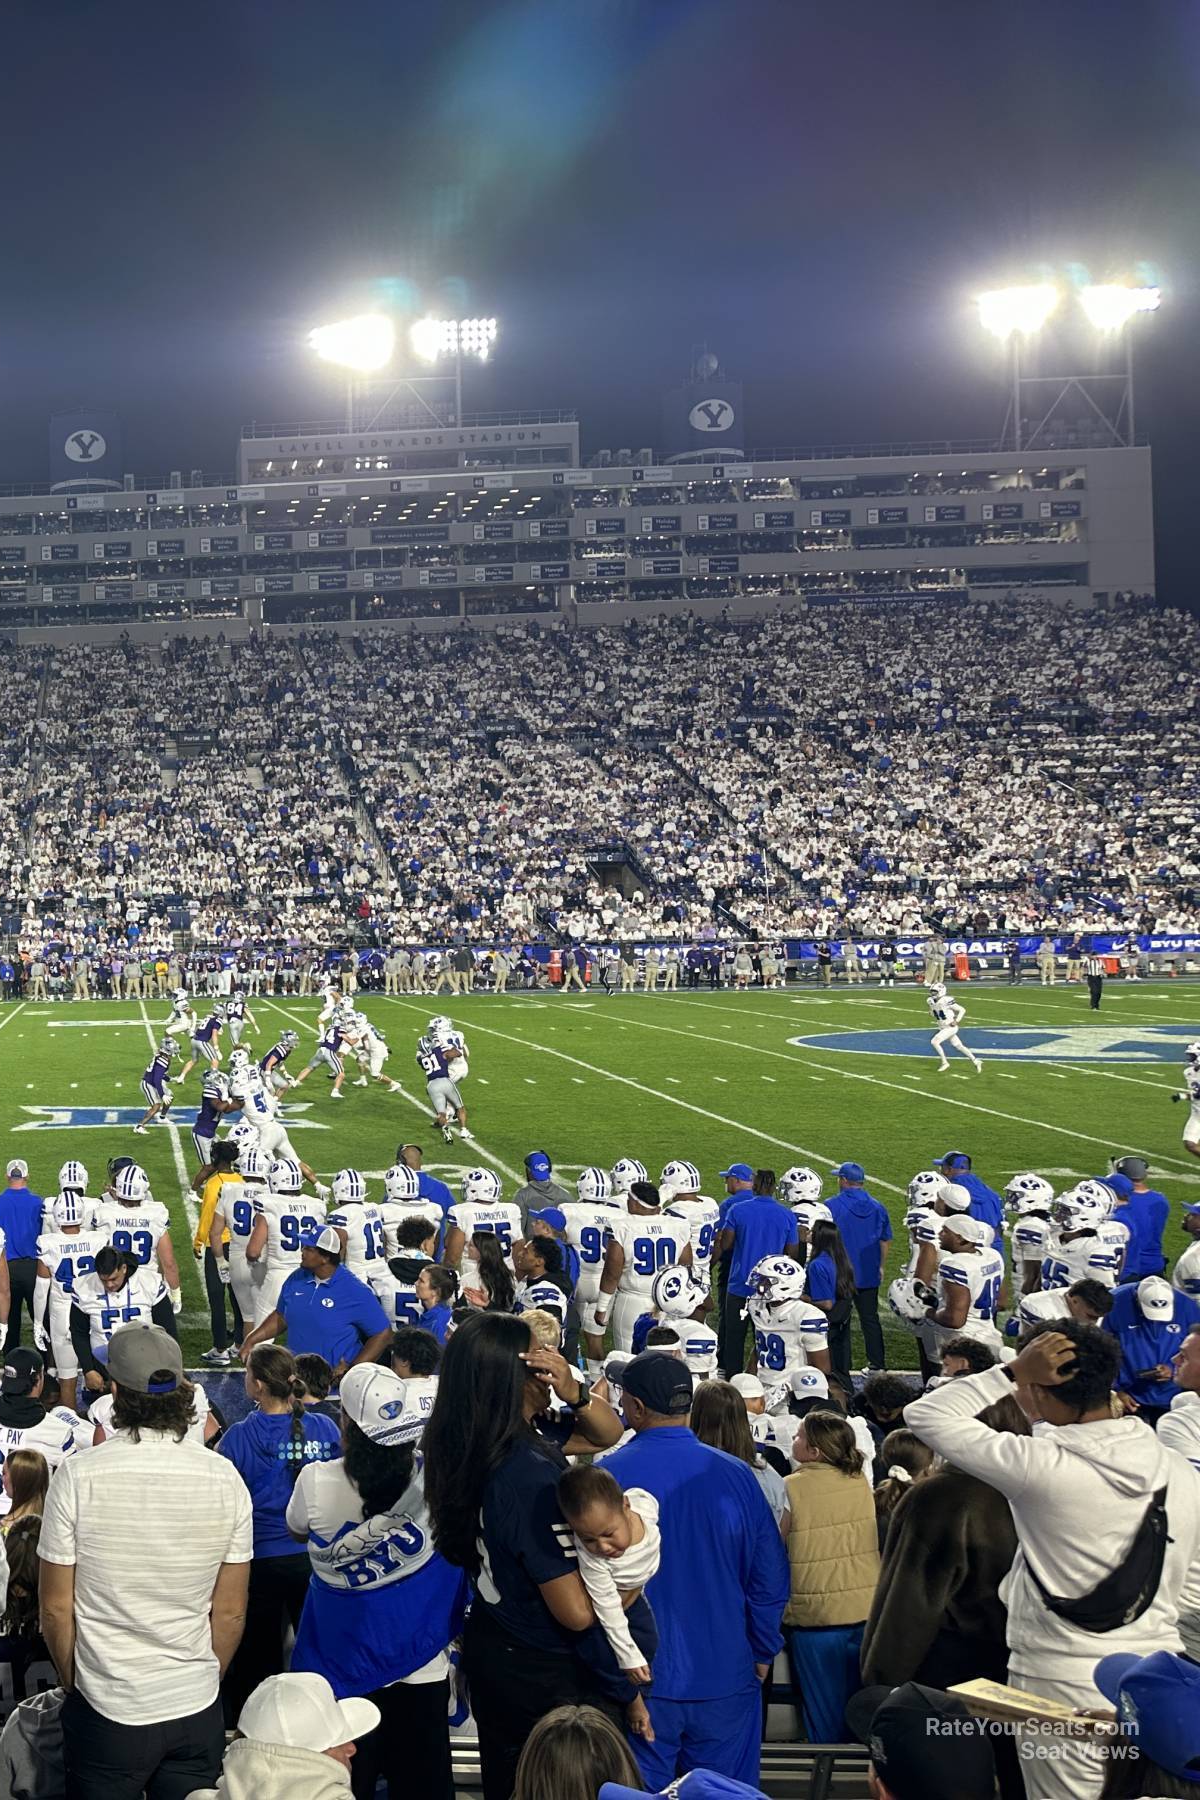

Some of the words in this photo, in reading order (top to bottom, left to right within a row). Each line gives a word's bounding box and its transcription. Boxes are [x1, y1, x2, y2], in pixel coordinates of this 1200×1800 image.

[697, 402, 728, 428] Y
[71, 433, 100, 459] Y
[279, 441, 343, 454] LAVELL
[358, 436, 444, 448] EDWARDS
[459, 431, 542, 444] STADIUM
[1151, 939, 1182, 948] BYU
[421, 1053, 442, 1075] 91
[115, 1217, 151, 1228] MANGELSON
[646, 1226, 663, 1235] LATU
[363, 1220, 386, 1260] 13
[633, 1237, 677, 1276] 90
[6, 1429, 24, 1446] PAY
[334, 1520, 427, 1588] BYU
